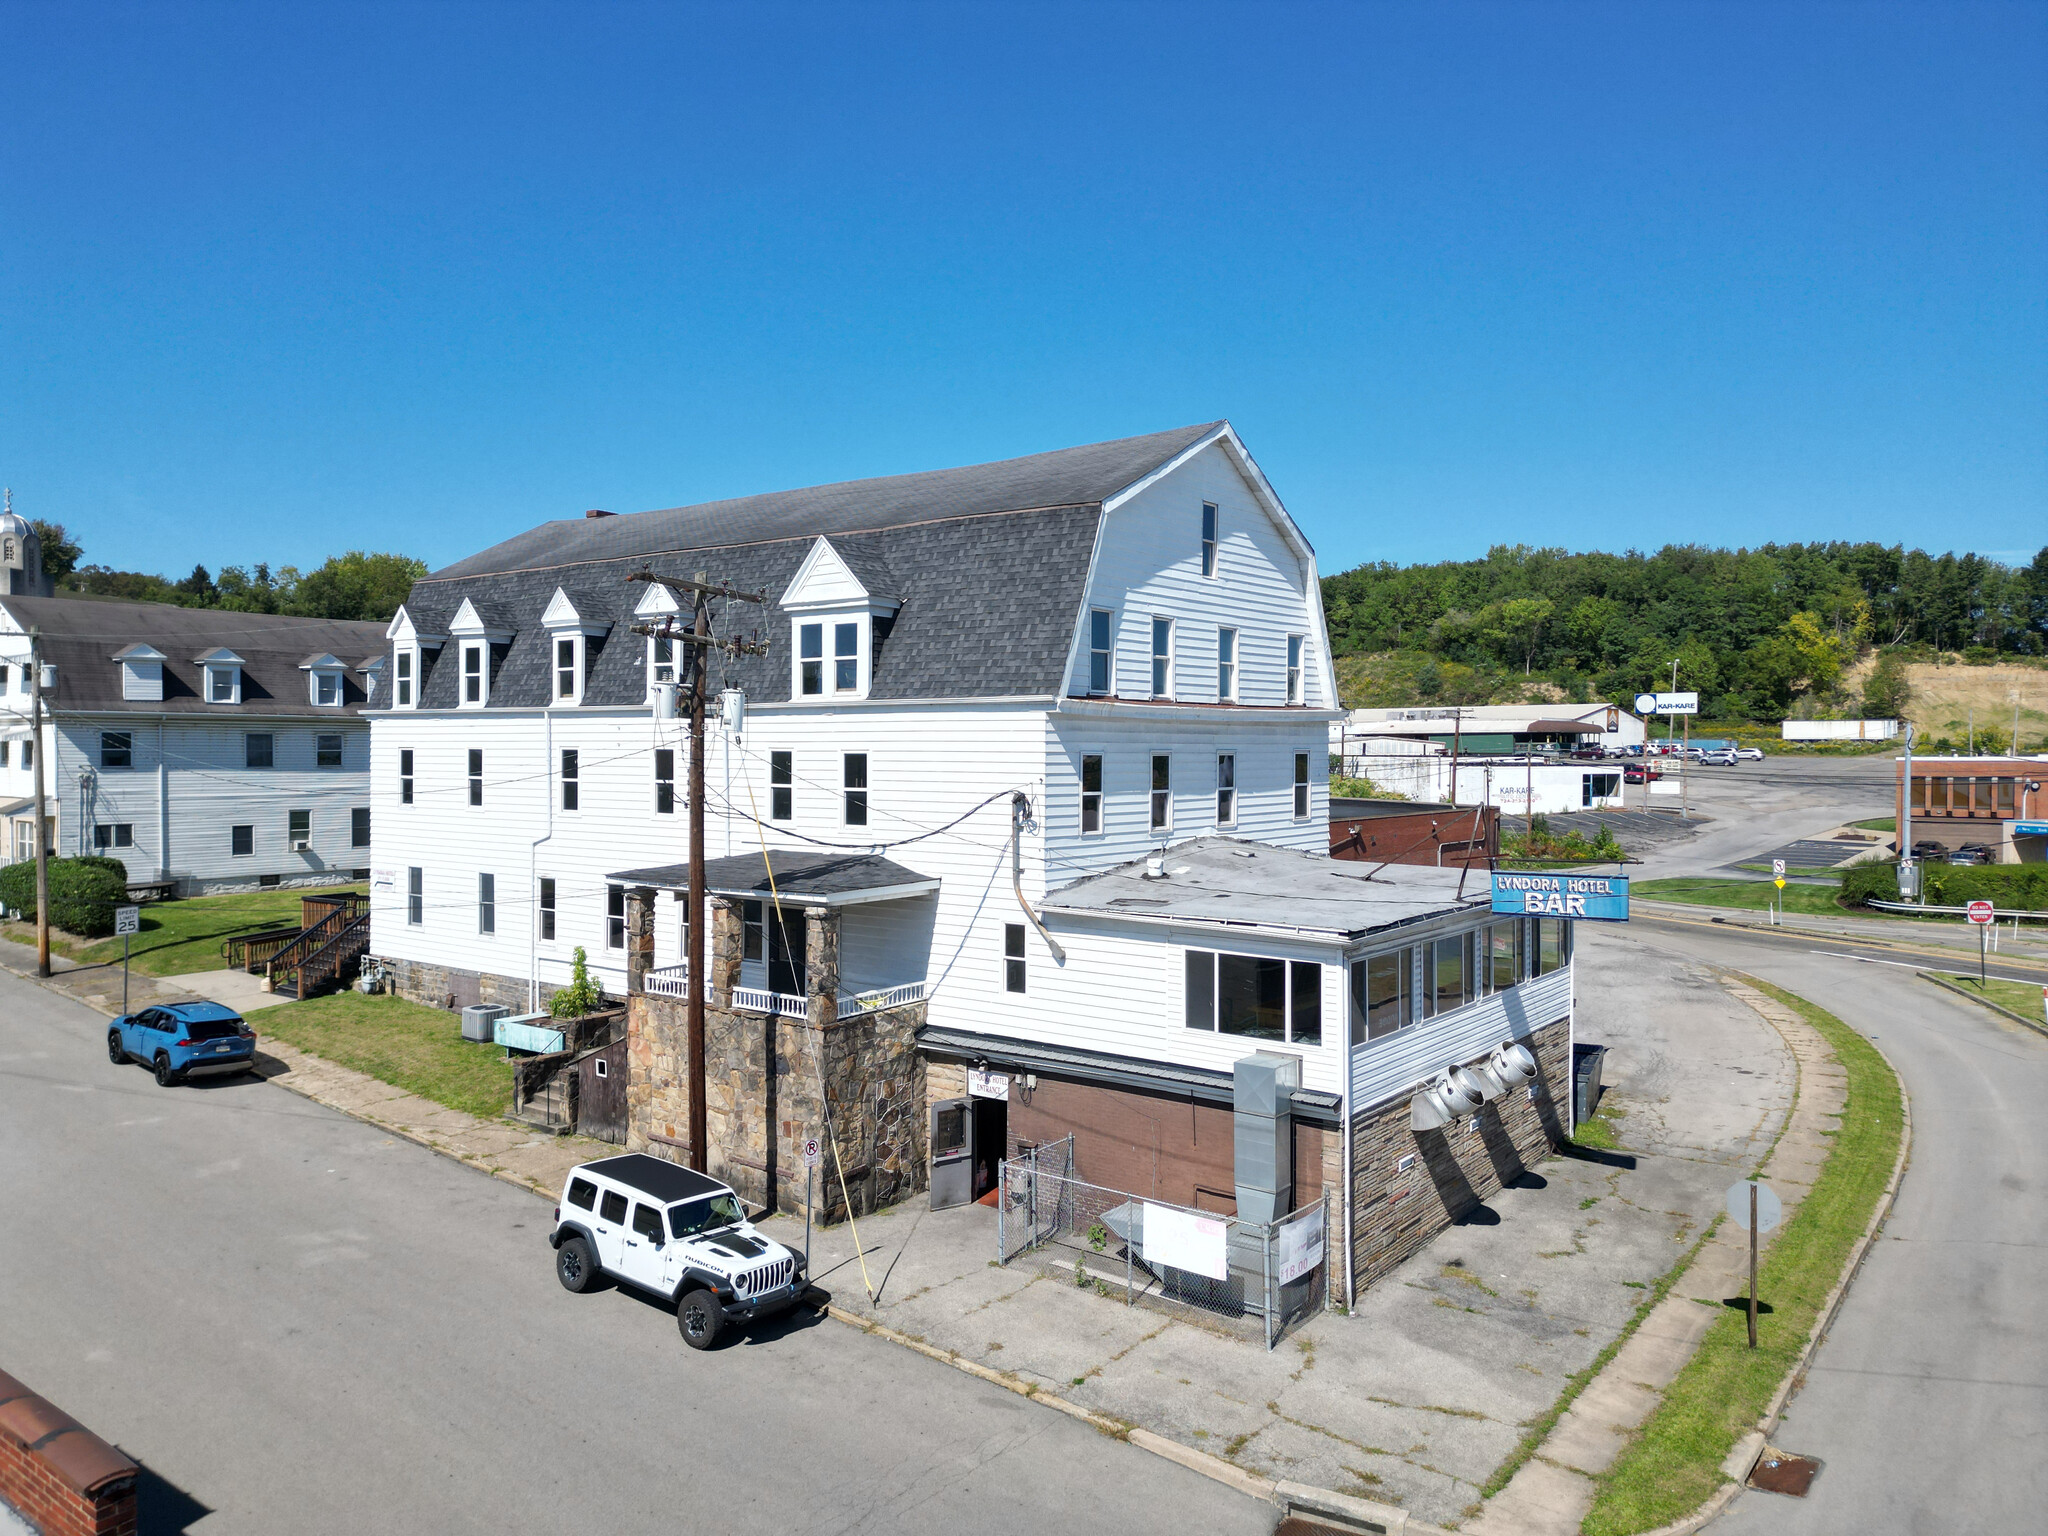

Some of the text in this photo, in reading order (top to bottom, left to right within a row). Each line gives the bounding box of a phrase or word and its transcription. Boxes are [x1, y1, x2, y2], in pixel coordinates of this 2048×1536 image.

[1497, 877, 1613, 893] LYNDORA HOTEL
[1524, 892, 1586, 916] BAR
[118, 920, 136, 932] 25
[992, 1075, 1007, 1086] HOTEL
[976, 1083, 1001, 1095] ENTRANCE
[685, 1255, 724, 1273] RUBICON
[1281, 1257, 1308, 1280] $18.00
